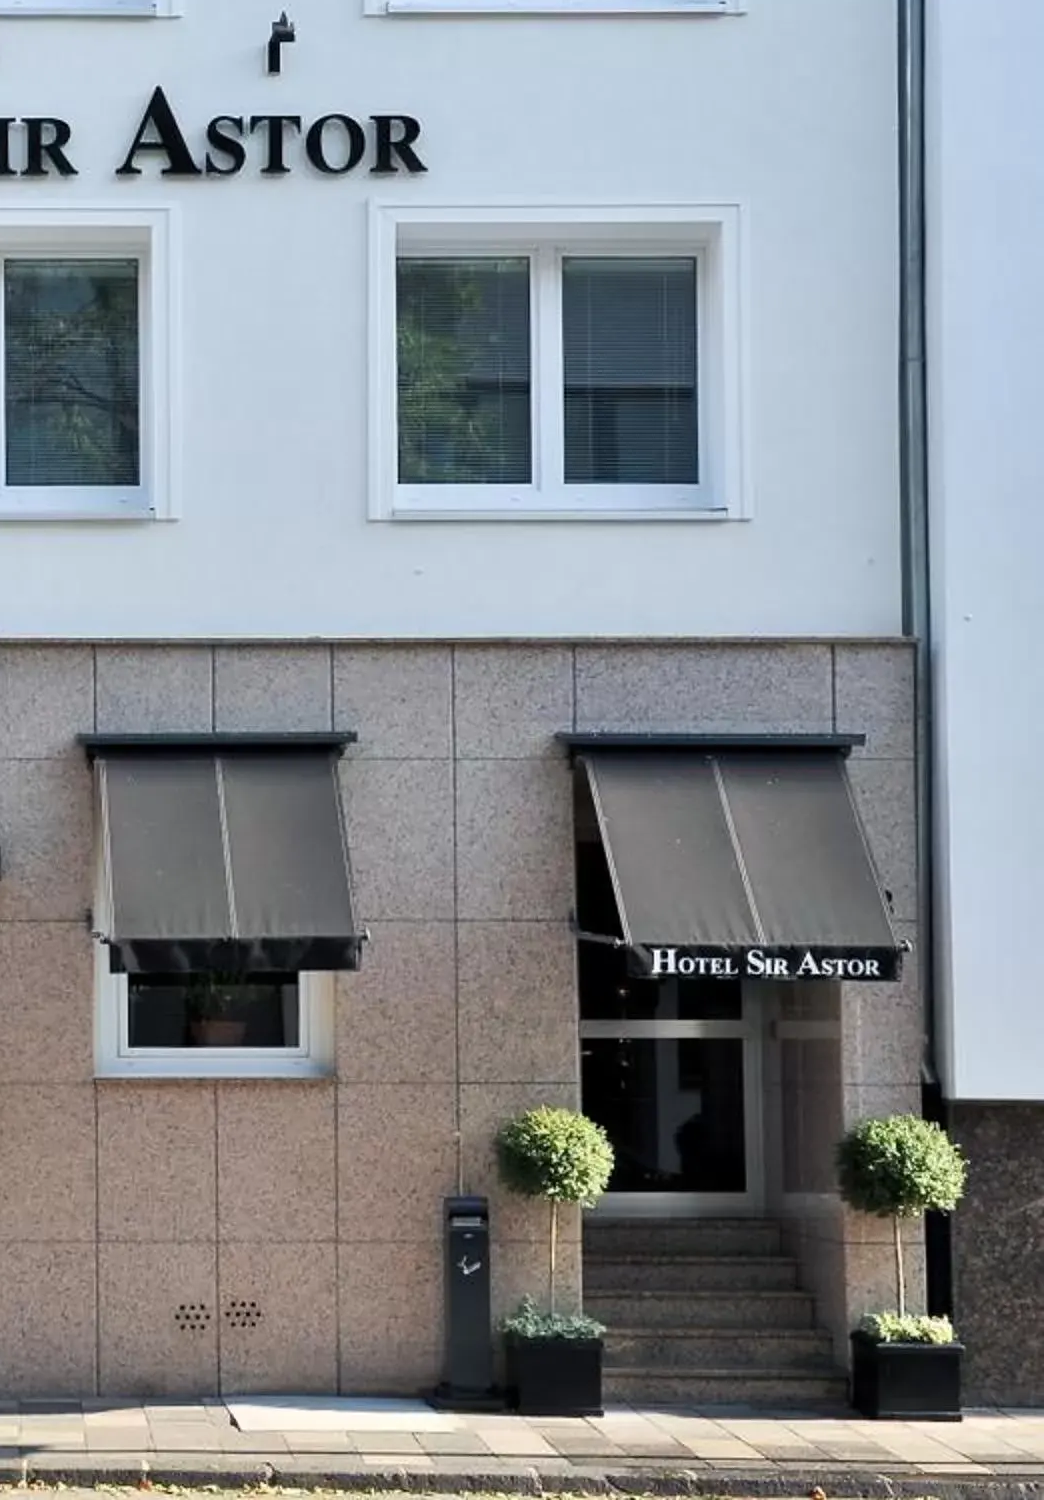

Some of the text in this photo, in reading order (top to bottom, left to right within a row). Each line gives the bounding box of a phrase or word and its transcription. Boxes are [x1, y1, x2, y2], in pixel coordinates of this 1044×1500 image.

[115, 85, 429, 178] ASTOR
[651, 948, 881, 976] HOTEL SIR ASTOR
